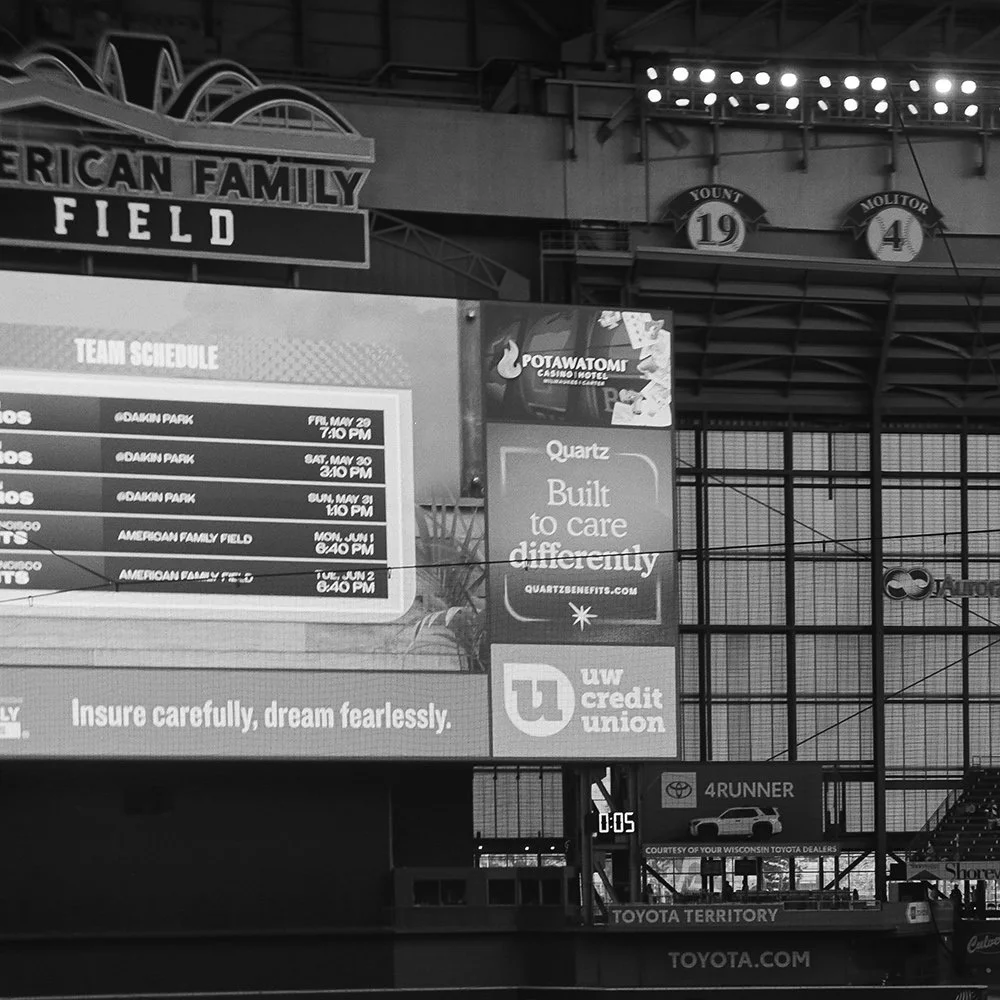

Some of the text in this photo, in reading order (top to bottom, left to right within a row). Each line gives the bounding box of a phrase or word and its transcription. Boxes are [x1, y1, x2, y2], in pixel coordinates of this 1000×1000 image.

[194, 158, 366, 208] FAMILY
[689, 187, 743, 203] YOUNT
[860, 194, 929, 216] MOLITOR
[54, 196, 235, 246] FIELD
[695, 213, 737, 246] 19
[881, 220, 904, 251] 4
[74, 337, 218, 369] TEAM SCHEDULE
[522, 354, 629, 372] POTAWATOMI
[114, 412, 194, 425] @DAIKIN PARK
[330, 416, 354, 428] MAY
[356, 417, 372, 428] 29
[319, 427, 372, 441] 7:10 PM
[116, 451, 195, 465] @DAIKIN PARK
[546, 439, 611, 462] Quartz
[330, 455, 355, 467] MAY
[356, 456, 372, 467] 30
[320, 466, 373, 480] 3:10 PM
[117, 491, 196, 504] @DAIKIN PARK
[335, 494, 359, 506] MAY
[361, 495, 373, 507] 31
[547, 478, 611, 507] Built
[326, 504, 374, 518] 1:10 PM
[530, 513, 628, 538] to care
[118, 530, 253, 545] AMERICAN FAMILY FIELD
[345, 533, 369, 544] JUN
[315, 543, 375, 556] 6:40 PM
[509, 541, 660, 578] differently
[119, 569, 180, 582] AMERICAN
[181, 571, 219, 584] FAMILY
[342, 571, 375, 582] JUN 2
[316, 580, 376, 594] 6:40 PM
[525, 584, 638, 597] QUARTZBENEFITS.COM
[580, 668, 624, 685] uw
[580, 686, 663, 709] credit
[72, 697, 451, 734] Insure carefully, dream fearlessly.
[580, 711, 666, 732] union
[704, 782, 795, 799] 4RUNNER
[598, 812, 635, 834] 0:05
[646, 845, 837, 855] COURTESY OF YOUR WISCONSIN TOYOTA DEALERS
[612, 908, 778, 925] TOYOTA TERRITORY
[668, 951, 811, 968] TOYOTA.COM
